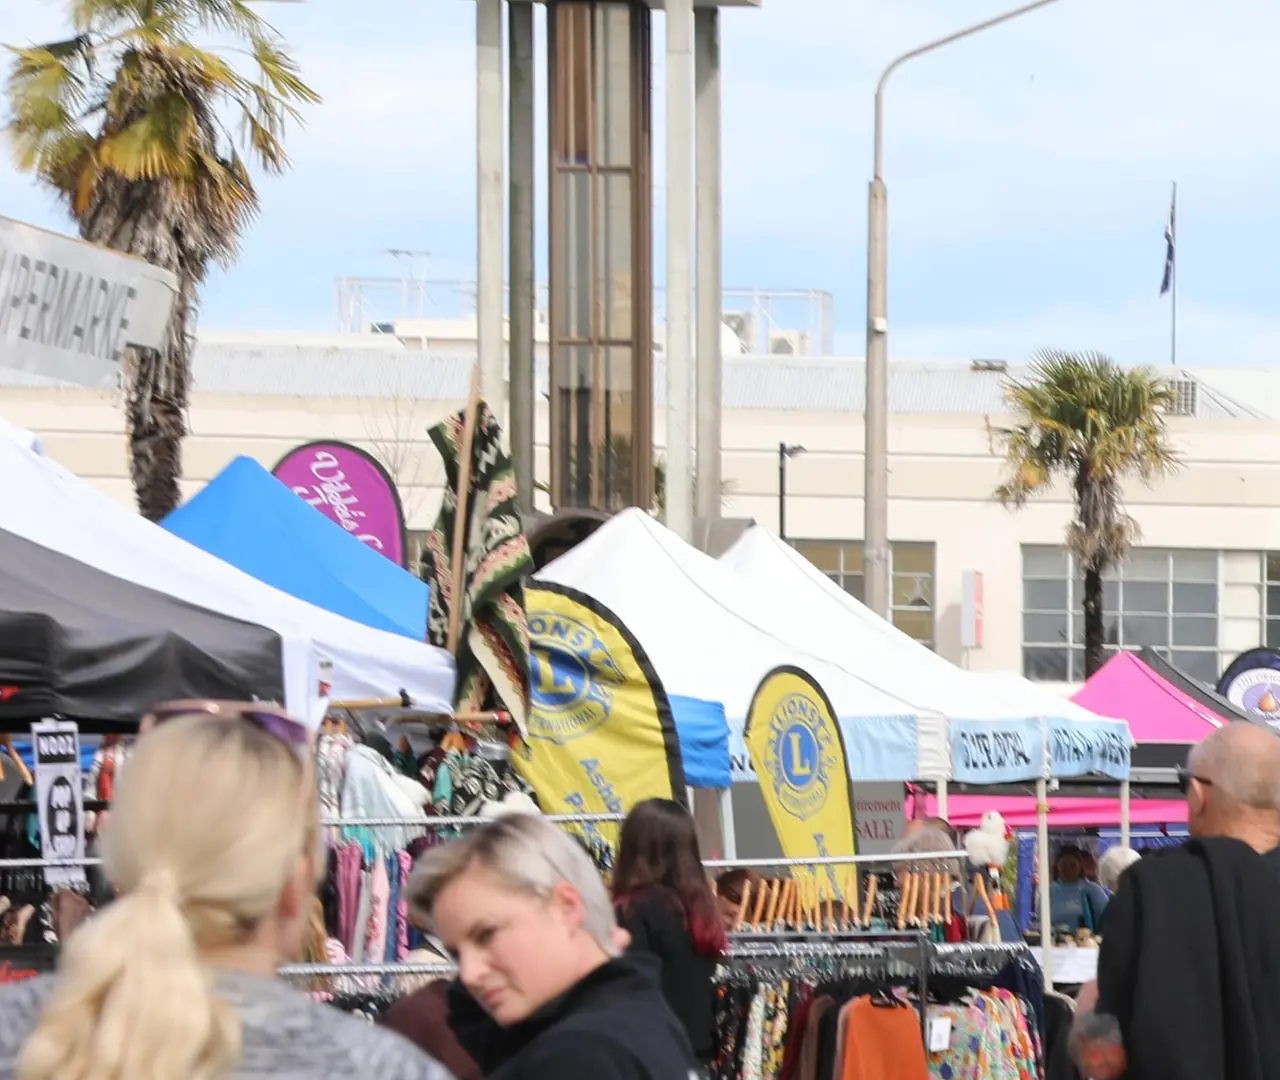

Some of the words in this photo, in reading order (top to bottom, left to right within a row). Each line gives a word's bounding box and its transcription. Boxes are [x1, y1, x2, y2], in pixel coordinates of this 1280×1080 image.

[528, 618, 587, 648] ONS
[537, 648, 578, 694] L
[37, 734, 76, 756] NOOZ
[787, 731, 812, 777] L
